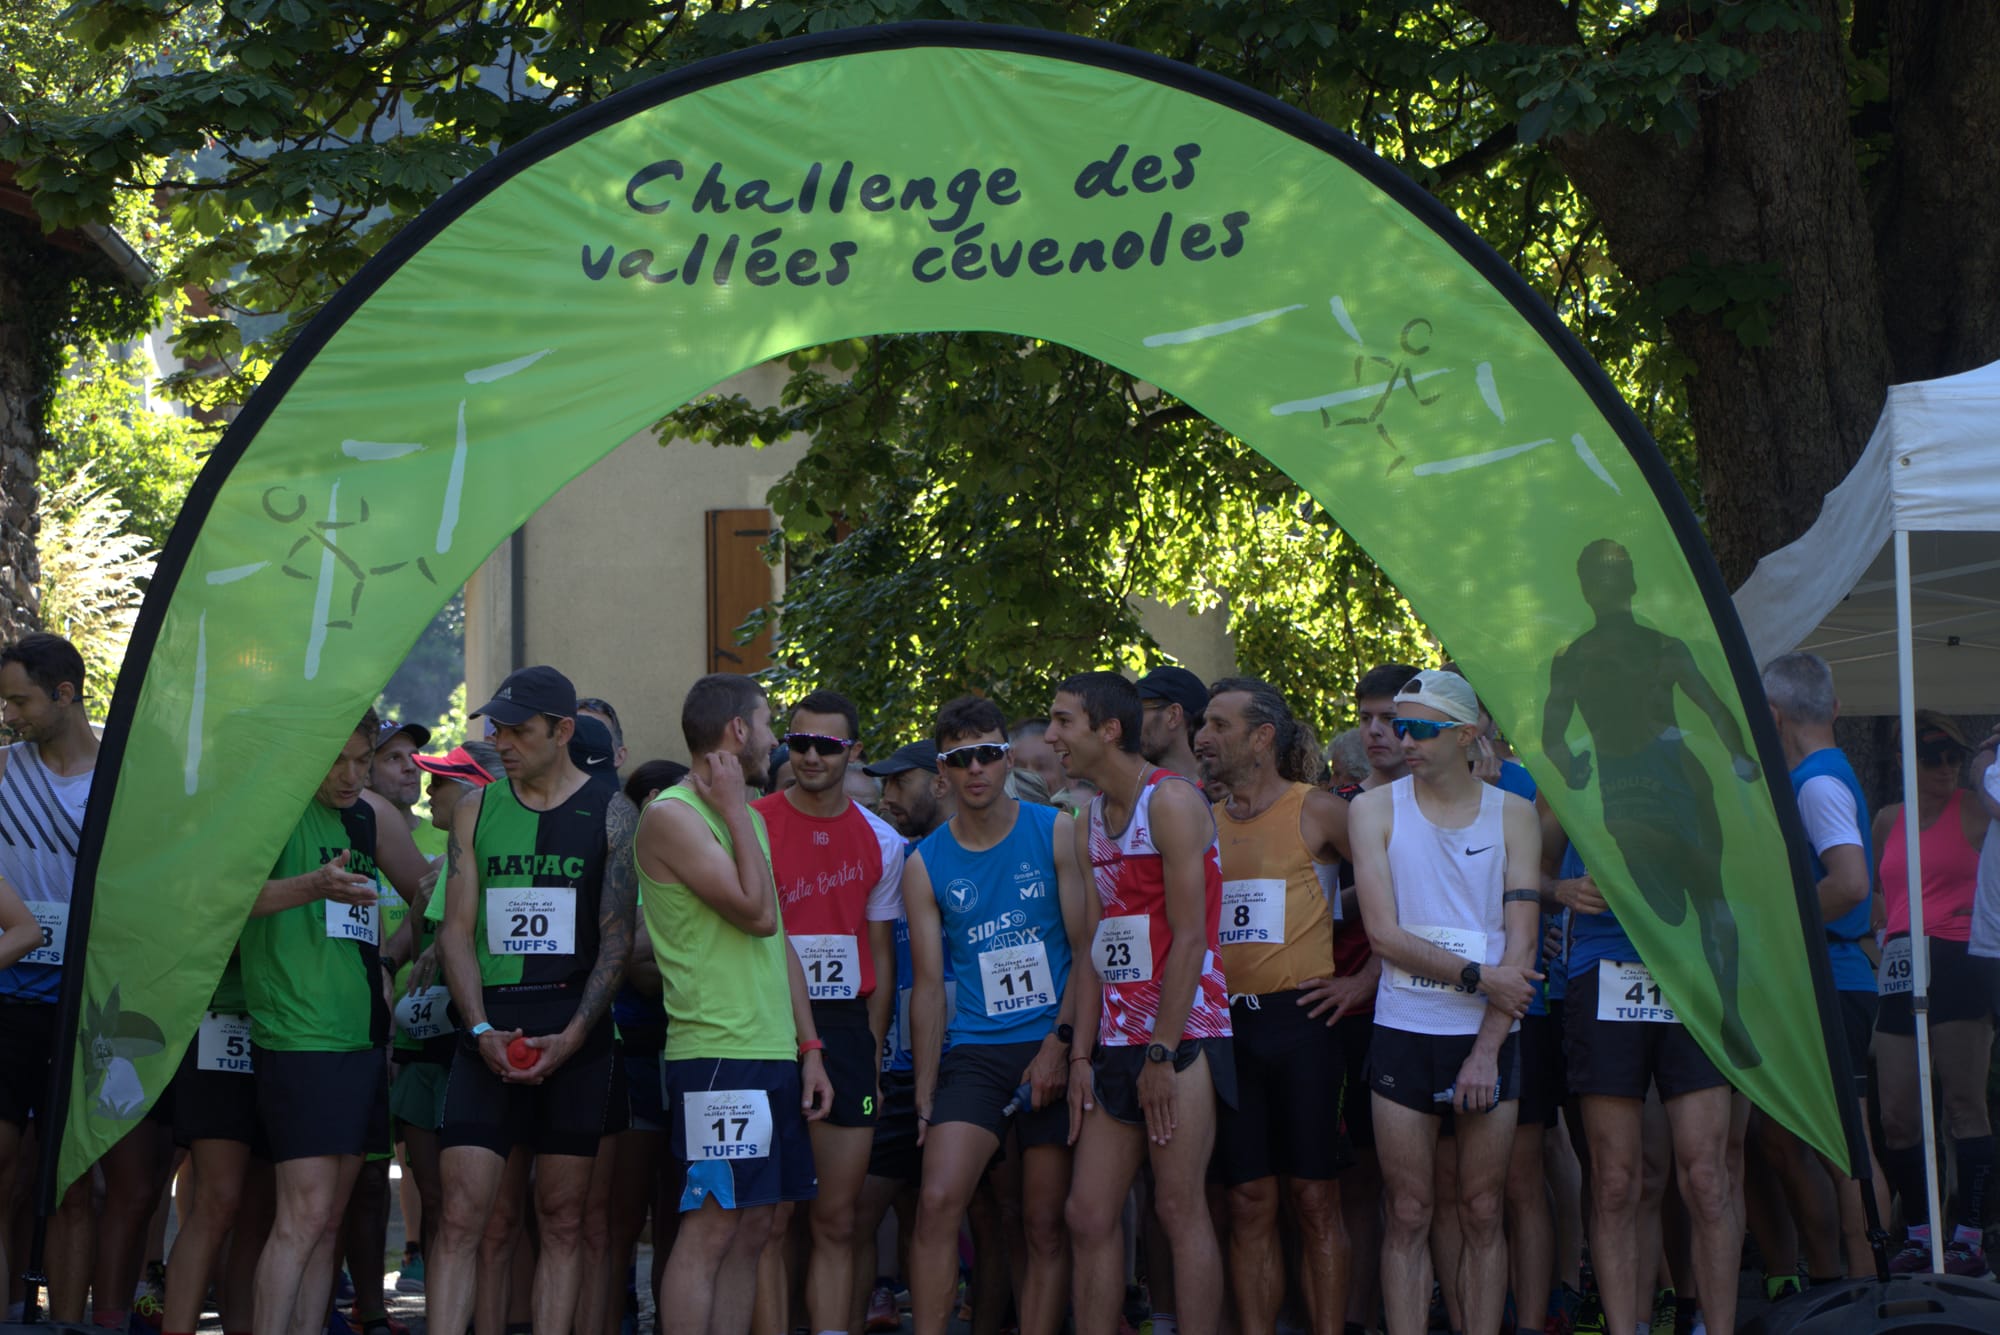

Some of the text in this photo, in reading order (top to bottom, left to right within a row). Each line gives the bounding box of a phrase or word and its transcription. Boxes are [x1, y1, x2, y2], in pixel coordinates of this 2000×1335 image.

[624, 142, 1202, 231] Challenge des
[581, 210, 1250, 286] vallées cévenoles
[487, 854, 585, 879] AATAC
[348, 902, 370, 926] 45
[1233, 904, 1250, 927] 8
[342, 924, 374, 942] TUFF'S
[510, 914, 549, 937] 20
[1219, 928, 1269, 943] TUFF'S
[502, 939, 558, 952] TUFF'S
[1106, 943, 1131, 966] 23
[27, 950, 60, 962] FF'S
[808, 960, 844, 982] 12
[1103, 967, 1141, 981] TUFF'S
[1887, 959, 1911, 979] 49
[809, 985, 852, 997] UFF'S
[1000, 969, 1034, 996] 11
[1410, 975, 1465, 992] TUFFS
[1883, 980, 1912, 992] TUFF'
[993, 992, 1048, 1012] TUFF'S
[1625, 982, 1661, 1006] 41
[410, 1002, 433, 1024] 34
[1616, 1007, 1675, 1020] TUFF'S
[407, 1024, 441, 1037] TUFF'S
[711, 1117, 749, 1142] 17
[702, 1143, 758, 1157] TUFF'S
